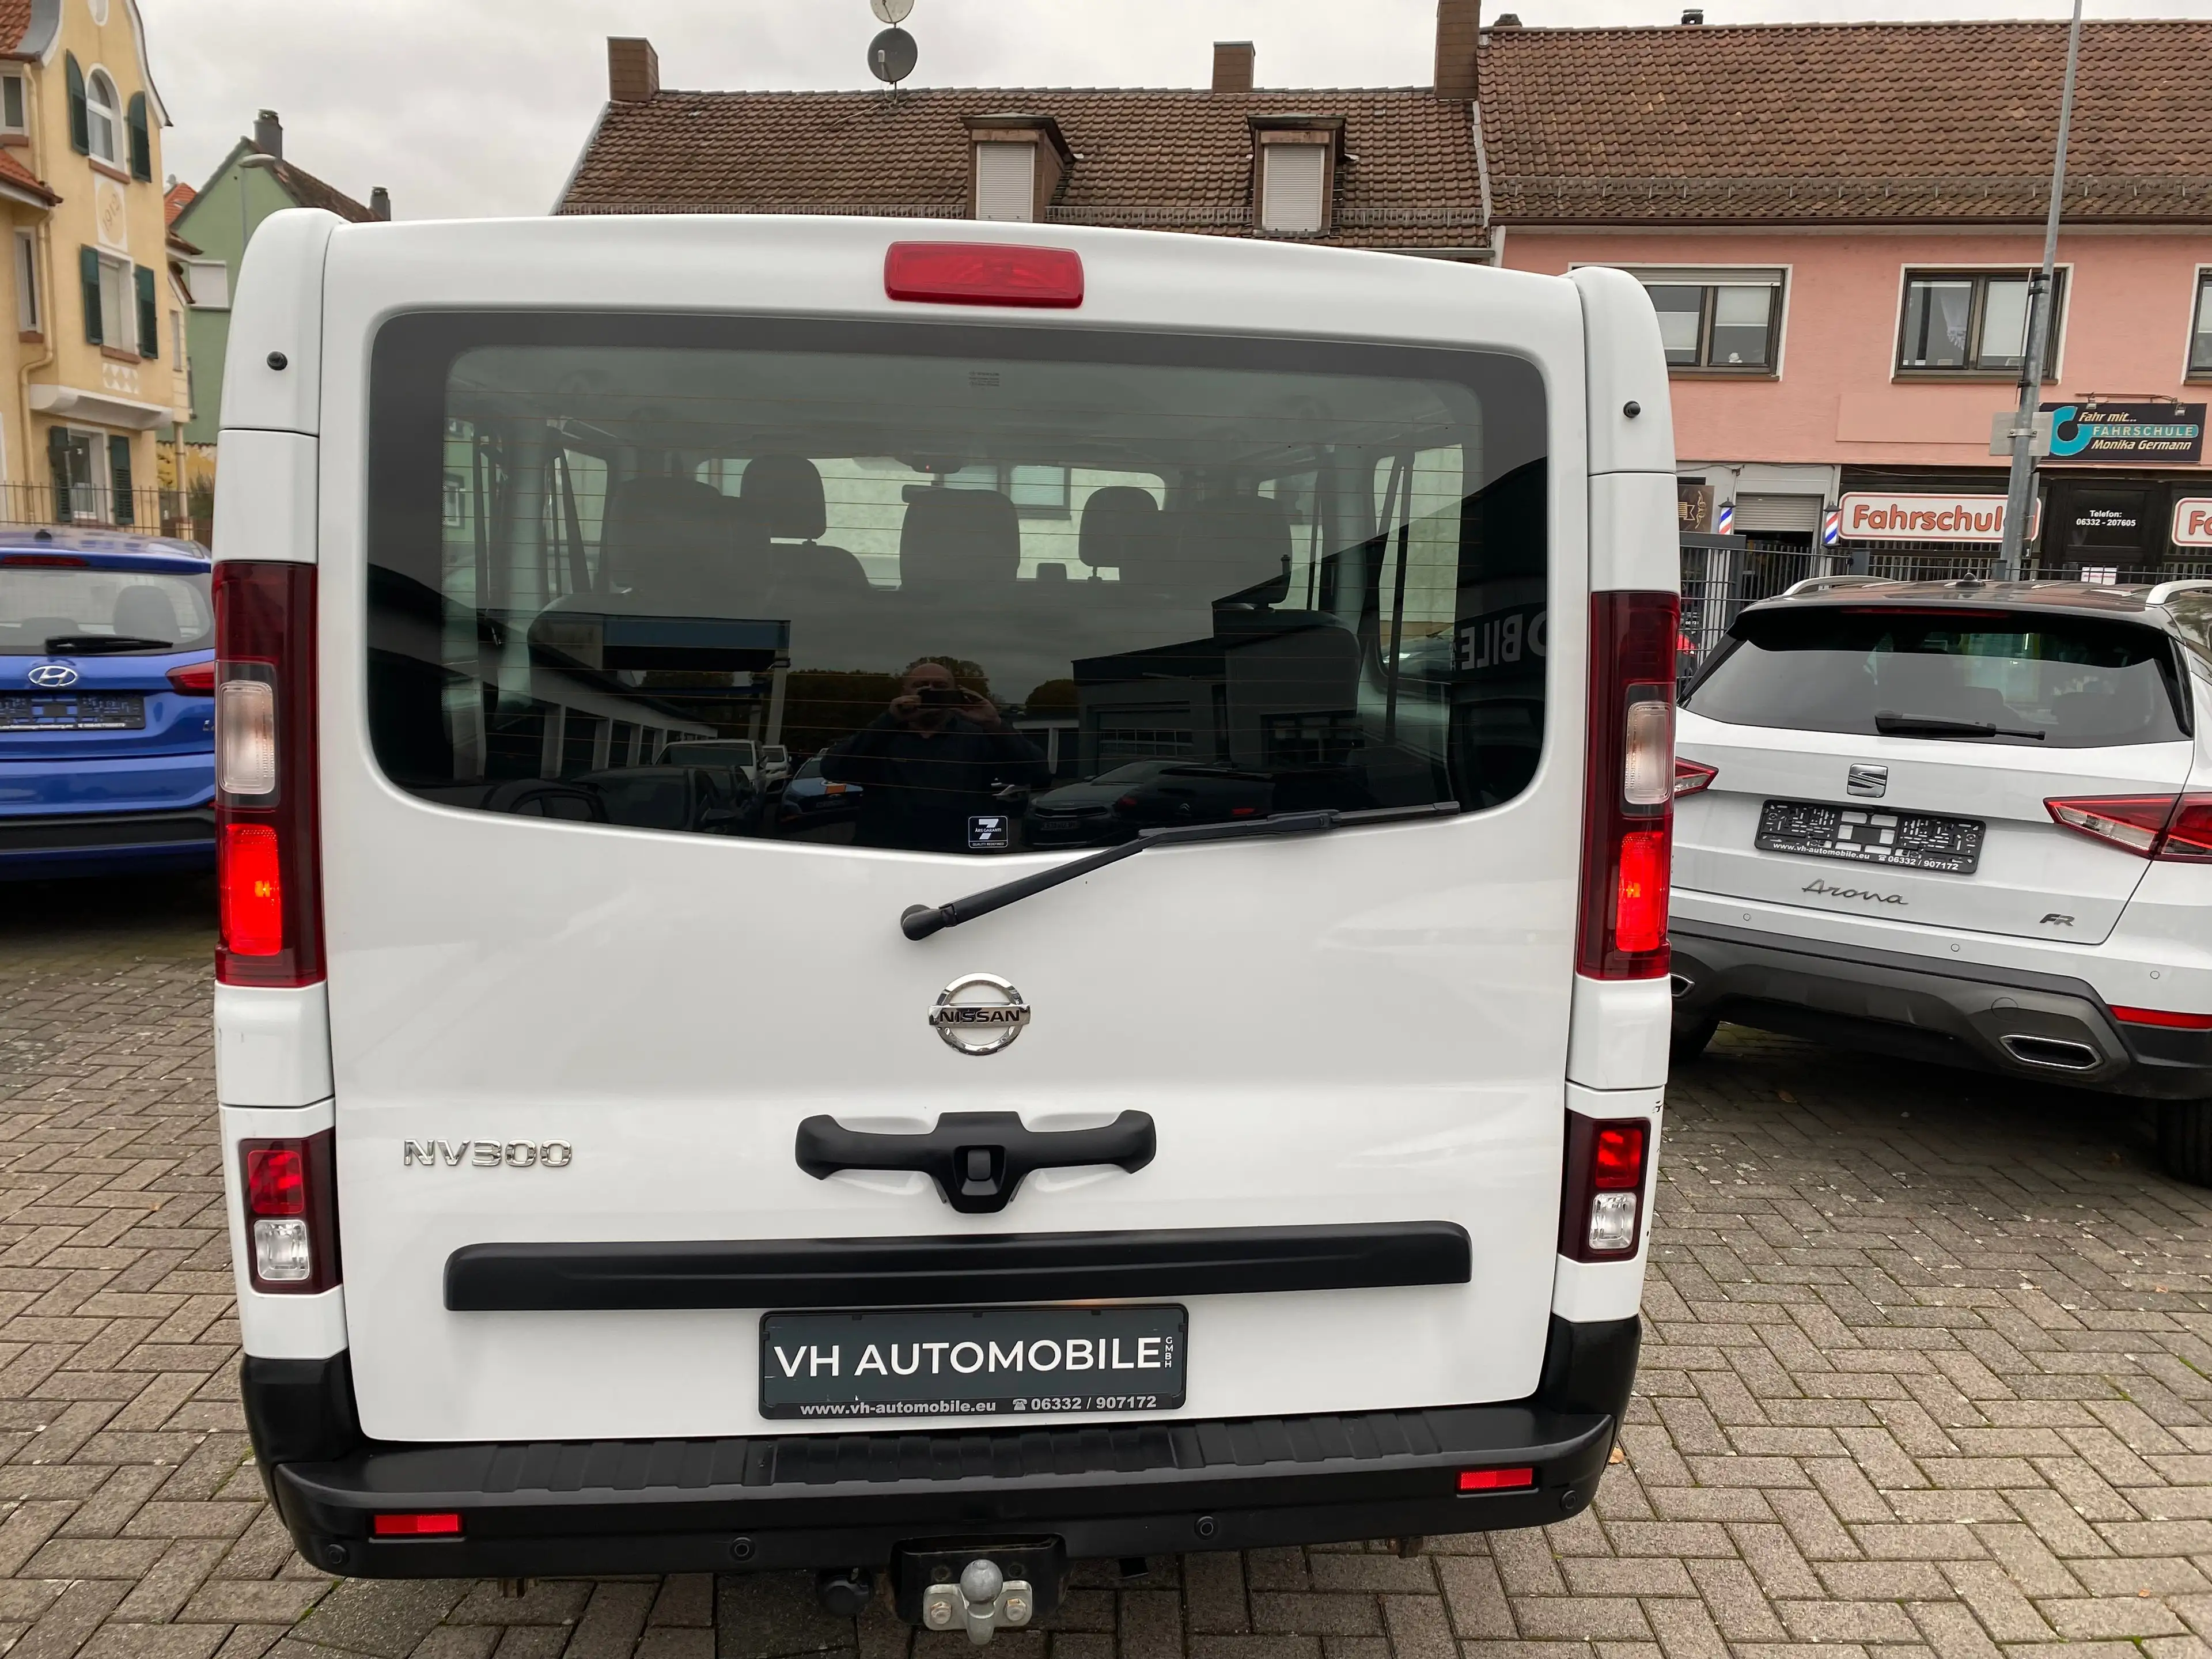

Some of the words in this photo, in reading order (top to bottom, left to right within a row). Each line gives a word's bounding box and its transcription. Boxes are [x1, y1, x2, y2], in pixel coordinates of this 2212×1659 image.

[2078, 411, 2106, 422] Fahr
[2092, 425, 2194, 437] FAHRSCHULE
[2091, 439, 2137, 450] Monika
[2138, 440, 2192, 451] Germann
[1853, 503, 2006, 532] Fahrschul
[2089, 509, 2123, 518] Telefon:
[2075, 518, 2100, 527] 06332
[2107, 518, 2137, 527] 207605
[1772, 842, 1871, 860] www.vh-automobile.eu
[1888, 856, 1916, 866] 06332
[1923, 860, 1959, 871] 907172
[1801, 878, 1909, 906] Arona
[2039, 912, 2075, 927] FR
[939, 1009, 1021, 1024] NISSAN
[403, 1138, 573, 1168] NV300
[773, 1344, 840, 1378] VH
[854, 1336, 1161, 1377] AUTOMOBILE
[1164, 1336, 1173, 1369] GMBH
[800, 1400, 997, 1415] www.vh-automobile.eu
[1031, 1397, 1082, 1410] 06332
[1096, 1395, 1157, 1410] 907172
